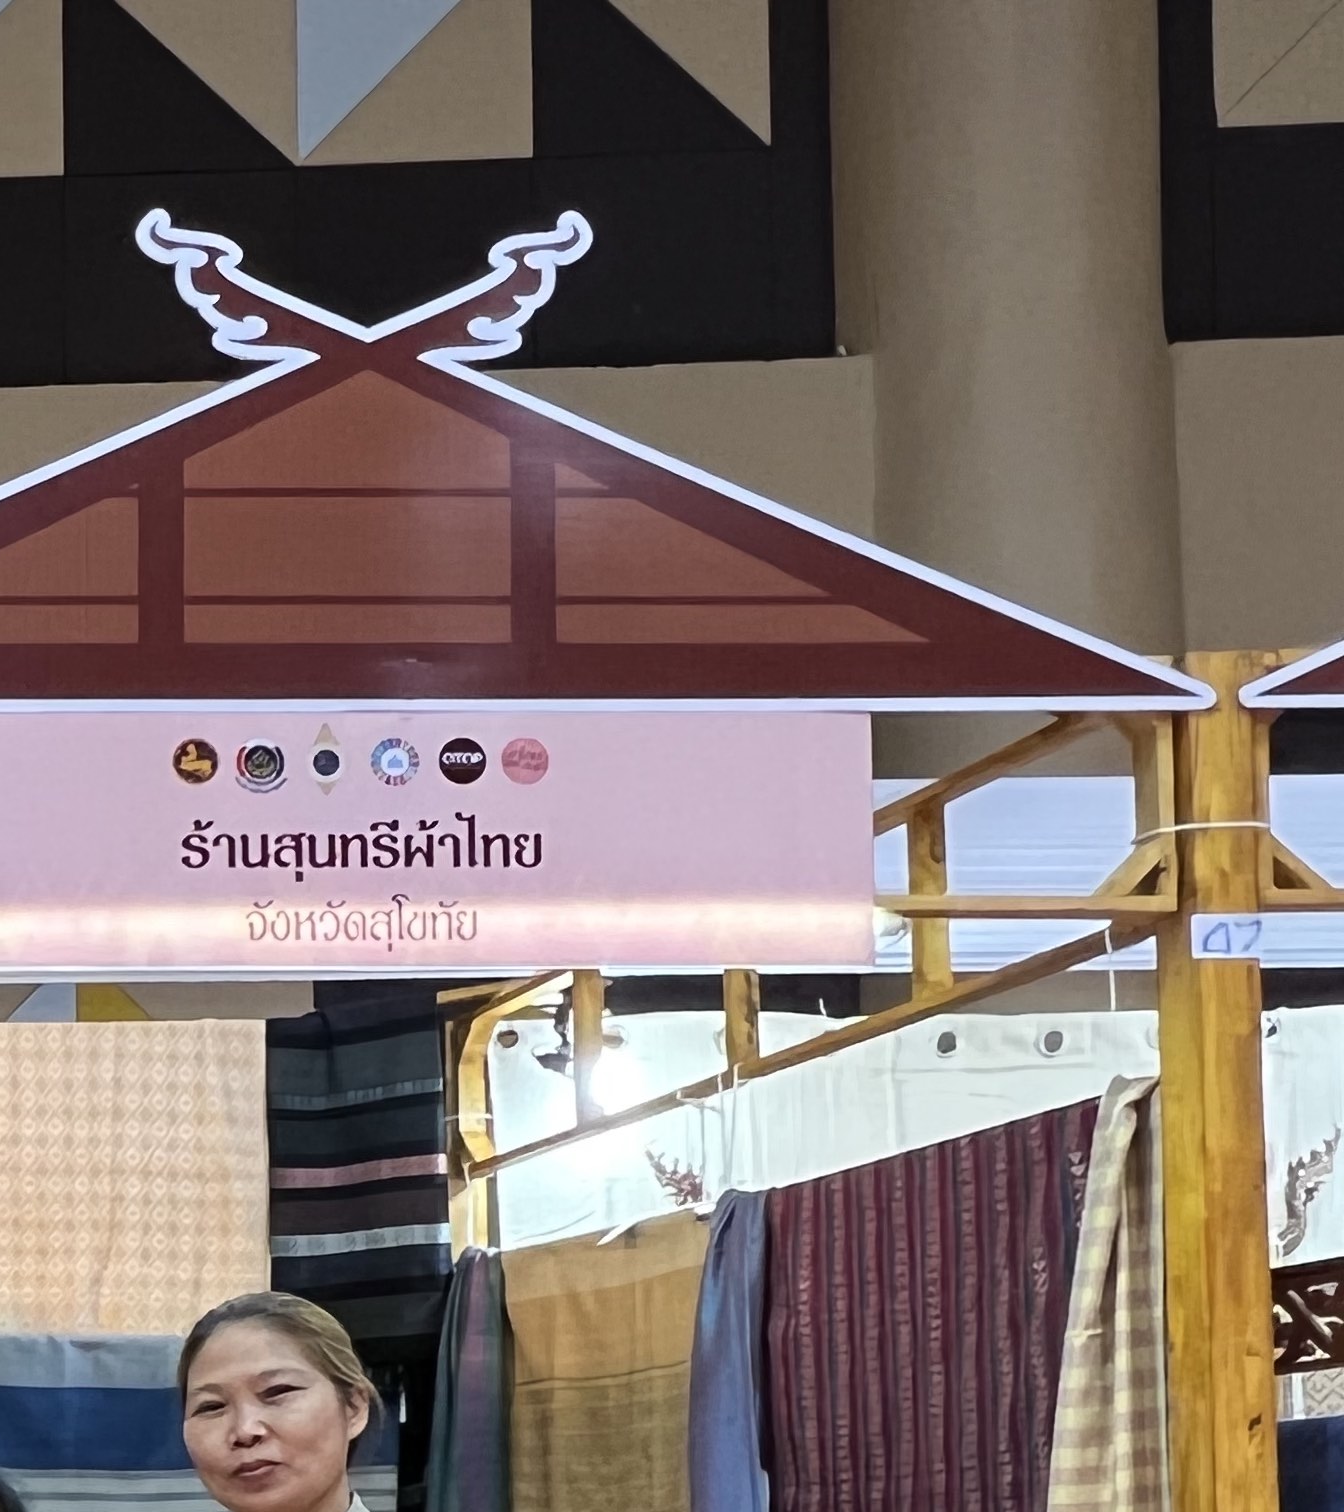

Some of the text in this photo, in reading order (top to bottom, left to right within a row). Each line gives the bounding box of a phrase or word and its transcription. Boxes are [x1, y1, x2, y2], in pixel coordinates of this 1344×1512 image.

[181, 811, 543, 882] ร้านสุนทรีผ้าไทย
[246, 893, 478, 952] จังหวัดสุโขทัย
